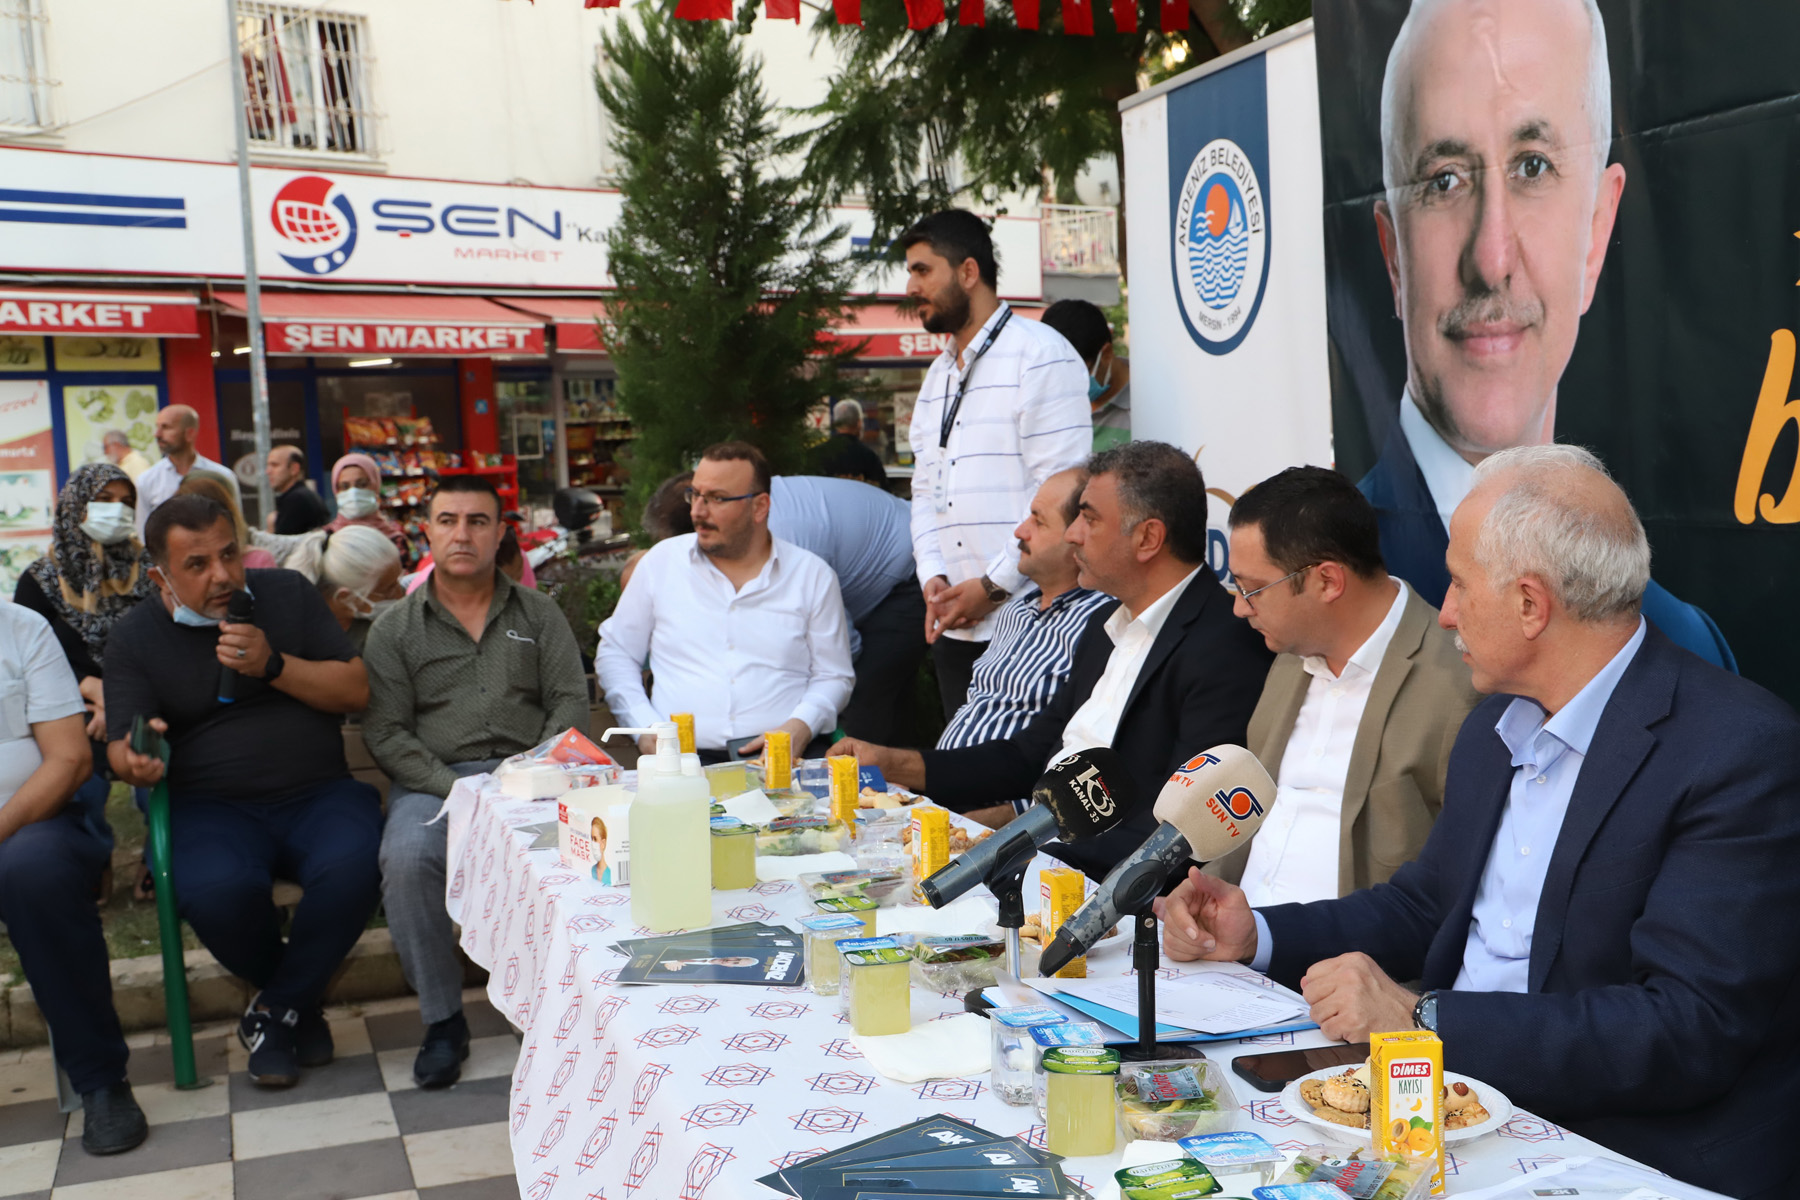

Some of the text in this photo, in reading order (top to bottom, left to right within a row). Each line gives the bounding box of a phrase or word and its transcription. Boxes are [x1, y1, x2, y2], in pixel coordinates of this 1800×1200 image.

[1178, 147, 1262, 246] AKDENİZ BELEDİYESİ
[372, 199, 562, 240] ŞEN
[453, 247, 563, 263] MARKET
[284, 324, 531, 351] ŞEN MARKET
[898, 334, 946, 358] ŞEN
[1068, 779, 1092, 812] KANAL
[1089, 811, 1100, 823] 33
[1205, 797, 1241, 838] SUN TV
[570, 834, 590, 852] FACE
[571, 846, 591, 862] MASK
[1392, 1063, 1429, 1077] DİMES
[1398, 1079, 1423, 1095] KAYISI
